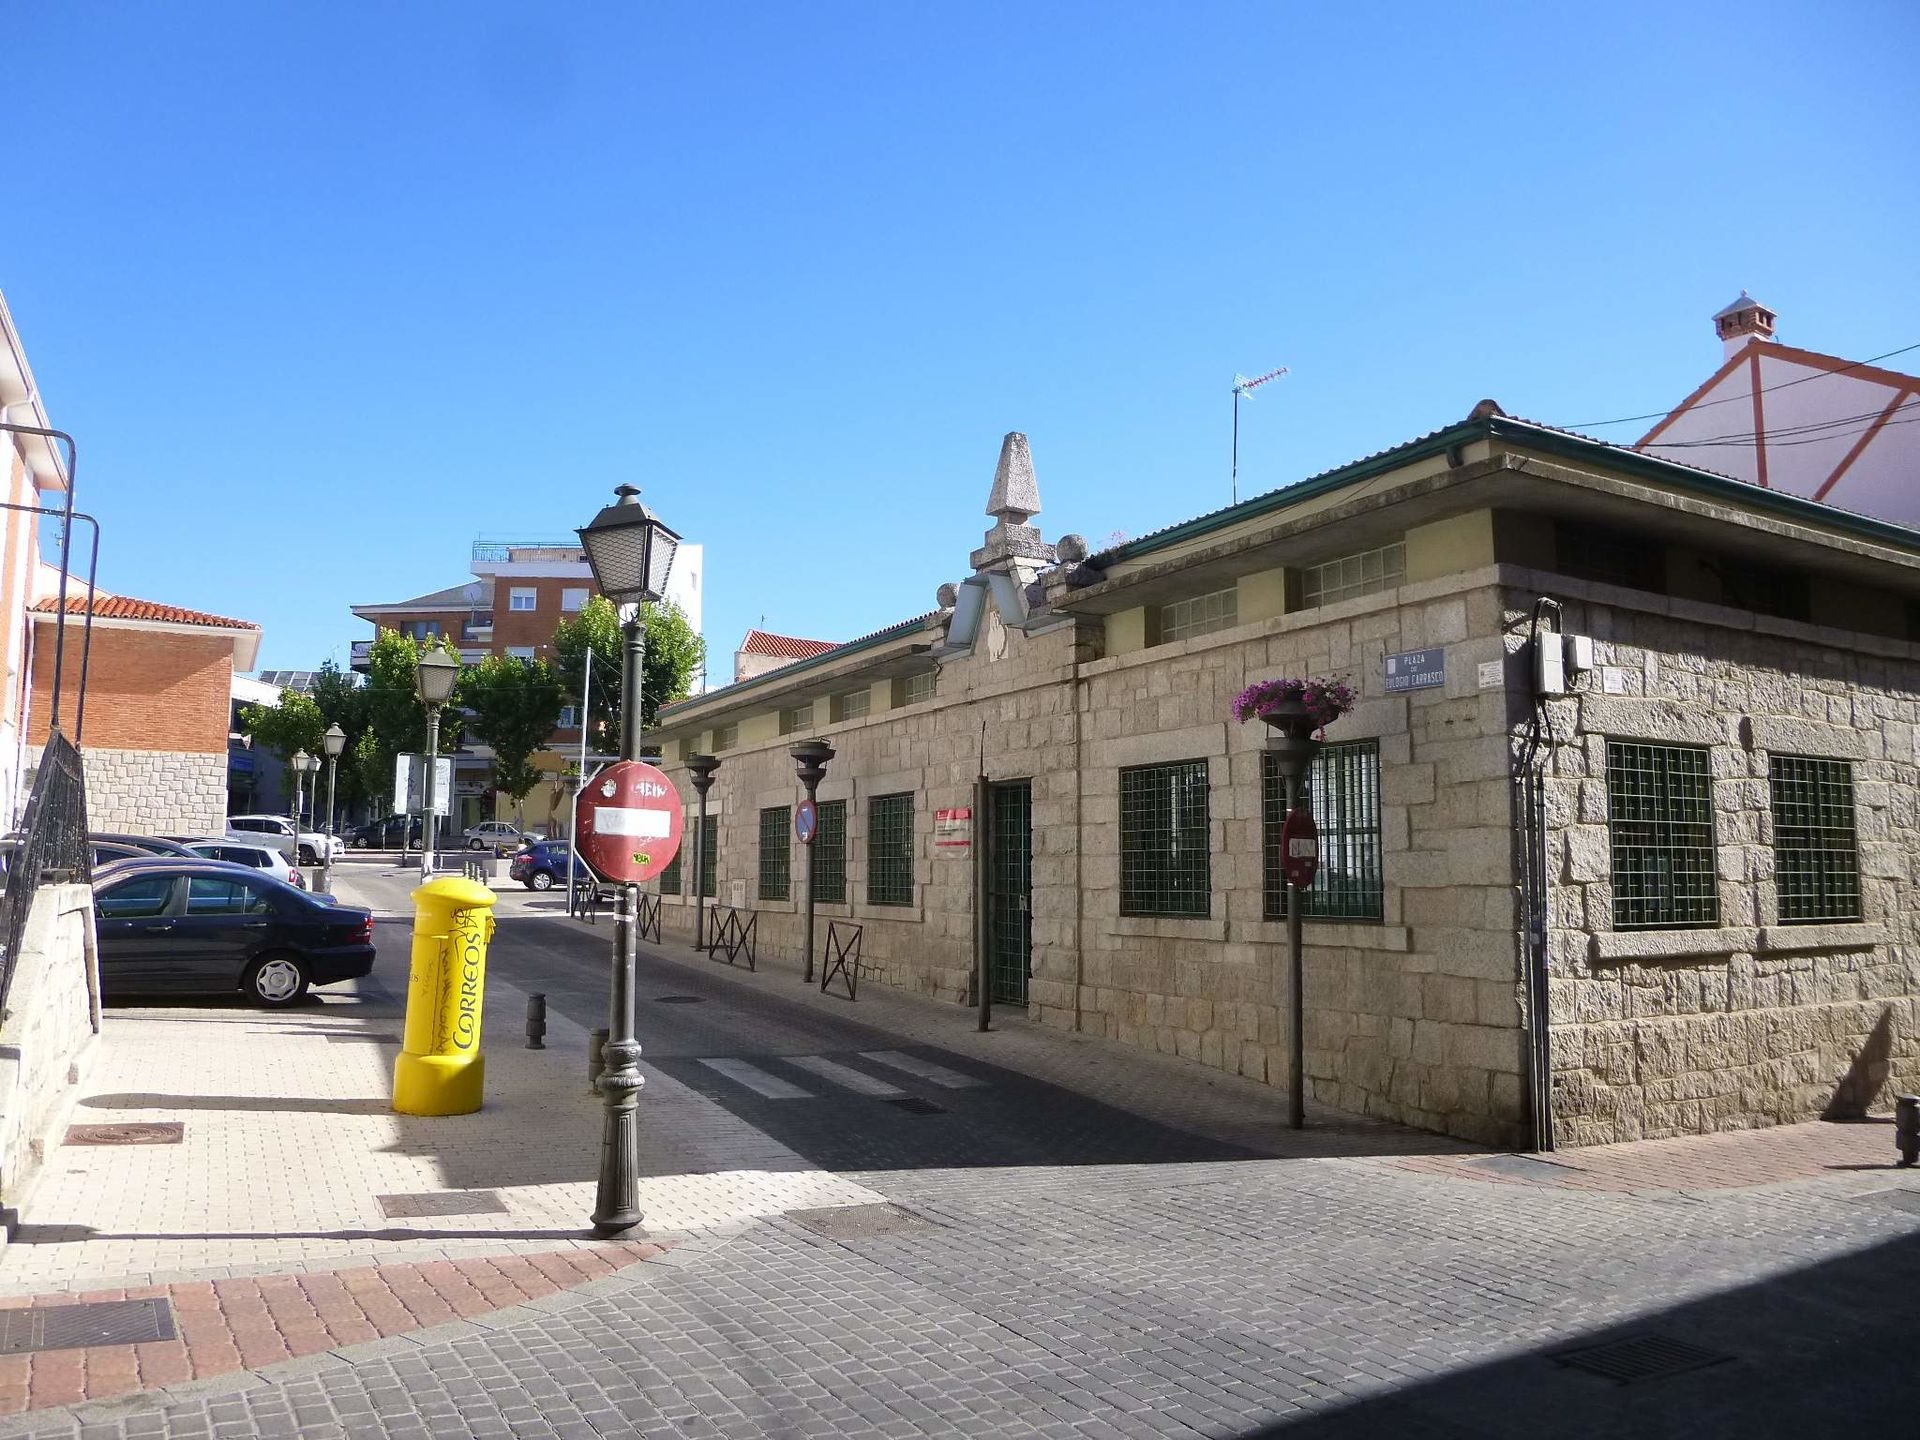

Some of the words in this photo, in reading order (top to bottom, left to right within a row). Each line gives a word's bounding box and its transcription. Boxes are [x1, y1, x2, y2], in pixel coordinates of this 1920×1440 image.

[1403, 654, 1425, 665] PLAZA
[1386, 675, 1409, 689] EULOGIO
[1411, 670, 1444, 686] CARRASCO
[452, 932, 481, 1050] CORREOS
